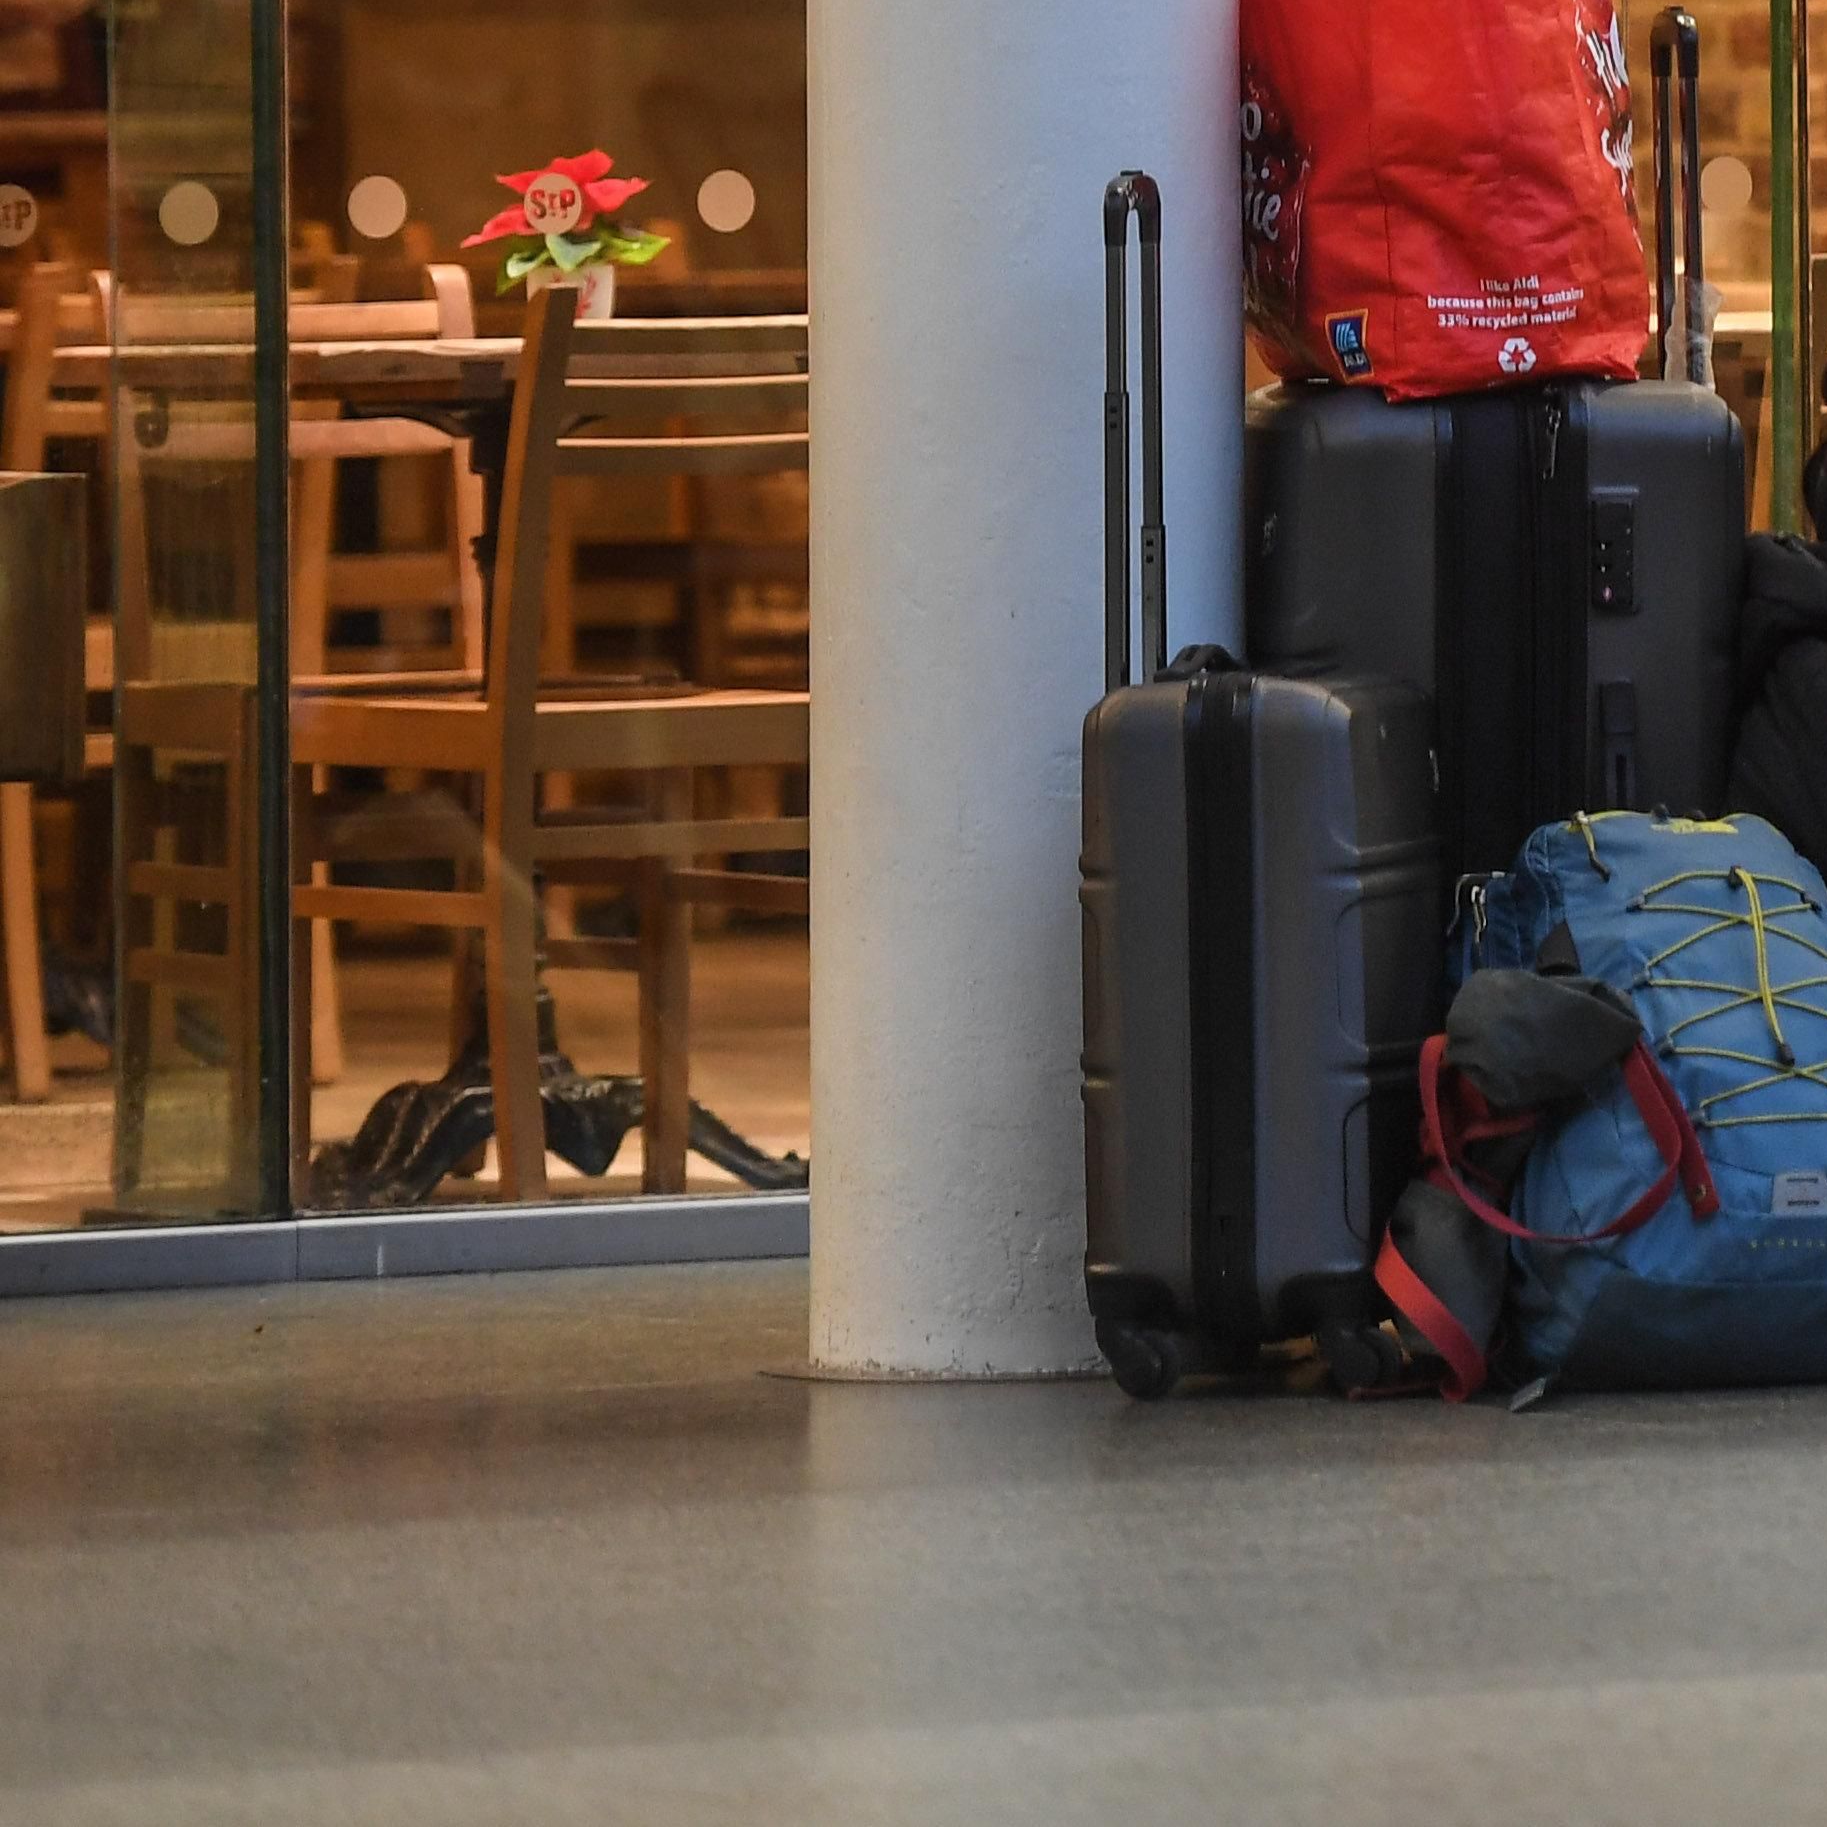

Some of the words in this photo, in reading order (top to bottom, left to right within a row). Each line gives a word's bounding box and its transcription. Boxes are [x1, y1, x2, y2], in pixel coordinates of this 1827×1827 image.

[1486, 278, 1510, 291] like
[1513, 274, 1540, 291] Aldi
[1427, 294, 1485, 309] because
[1486, 294, 1512, 308] this
[1514, 294, 1539, 311] bag
[1437, 313, 1470, 328] 33%
[1471, 311, 1528, 330] recycled
